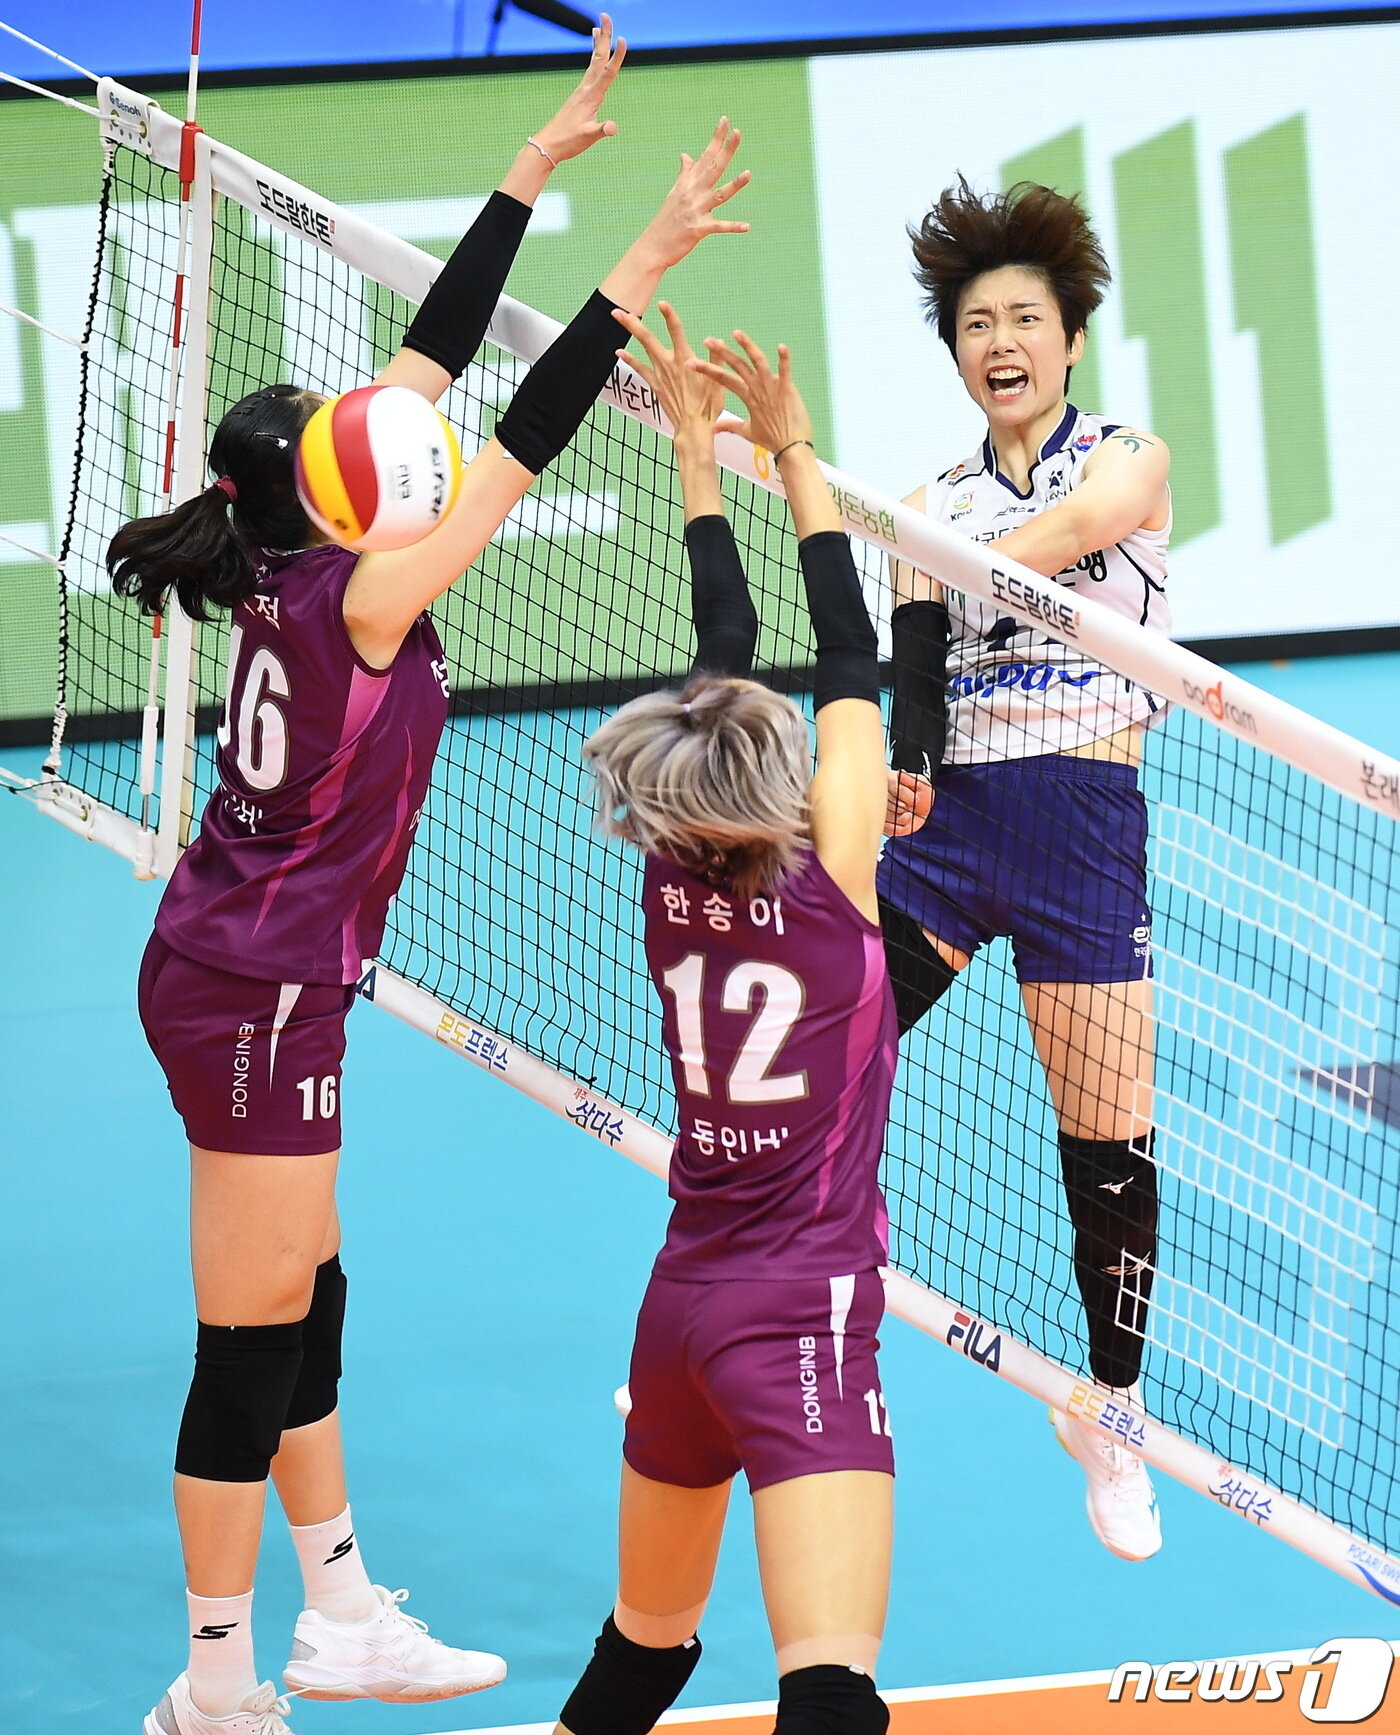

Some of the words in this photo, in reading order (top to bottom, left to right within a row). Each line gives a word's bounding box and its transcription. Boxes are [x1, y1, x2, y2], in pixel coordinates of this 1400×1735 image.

[256, 178, 333, 248] 도드람한돈
[991, 567, 1079, 639] 도드람한돈
[660, 883, 785, 936] 한송이
[435, 1011, 509, 1072] 몬도프렉스
[662, 950, 810, 1106] 12
[296, 1075, 337, 1121] 16
[564, 1100, 625, 1147] 삼다수
[946, 1312, 1002, 1374] FILA
[1066, 1384, 1146, 1447] 몬도프렉스
[1208, 1479, 1273, 1526] 삼다수
